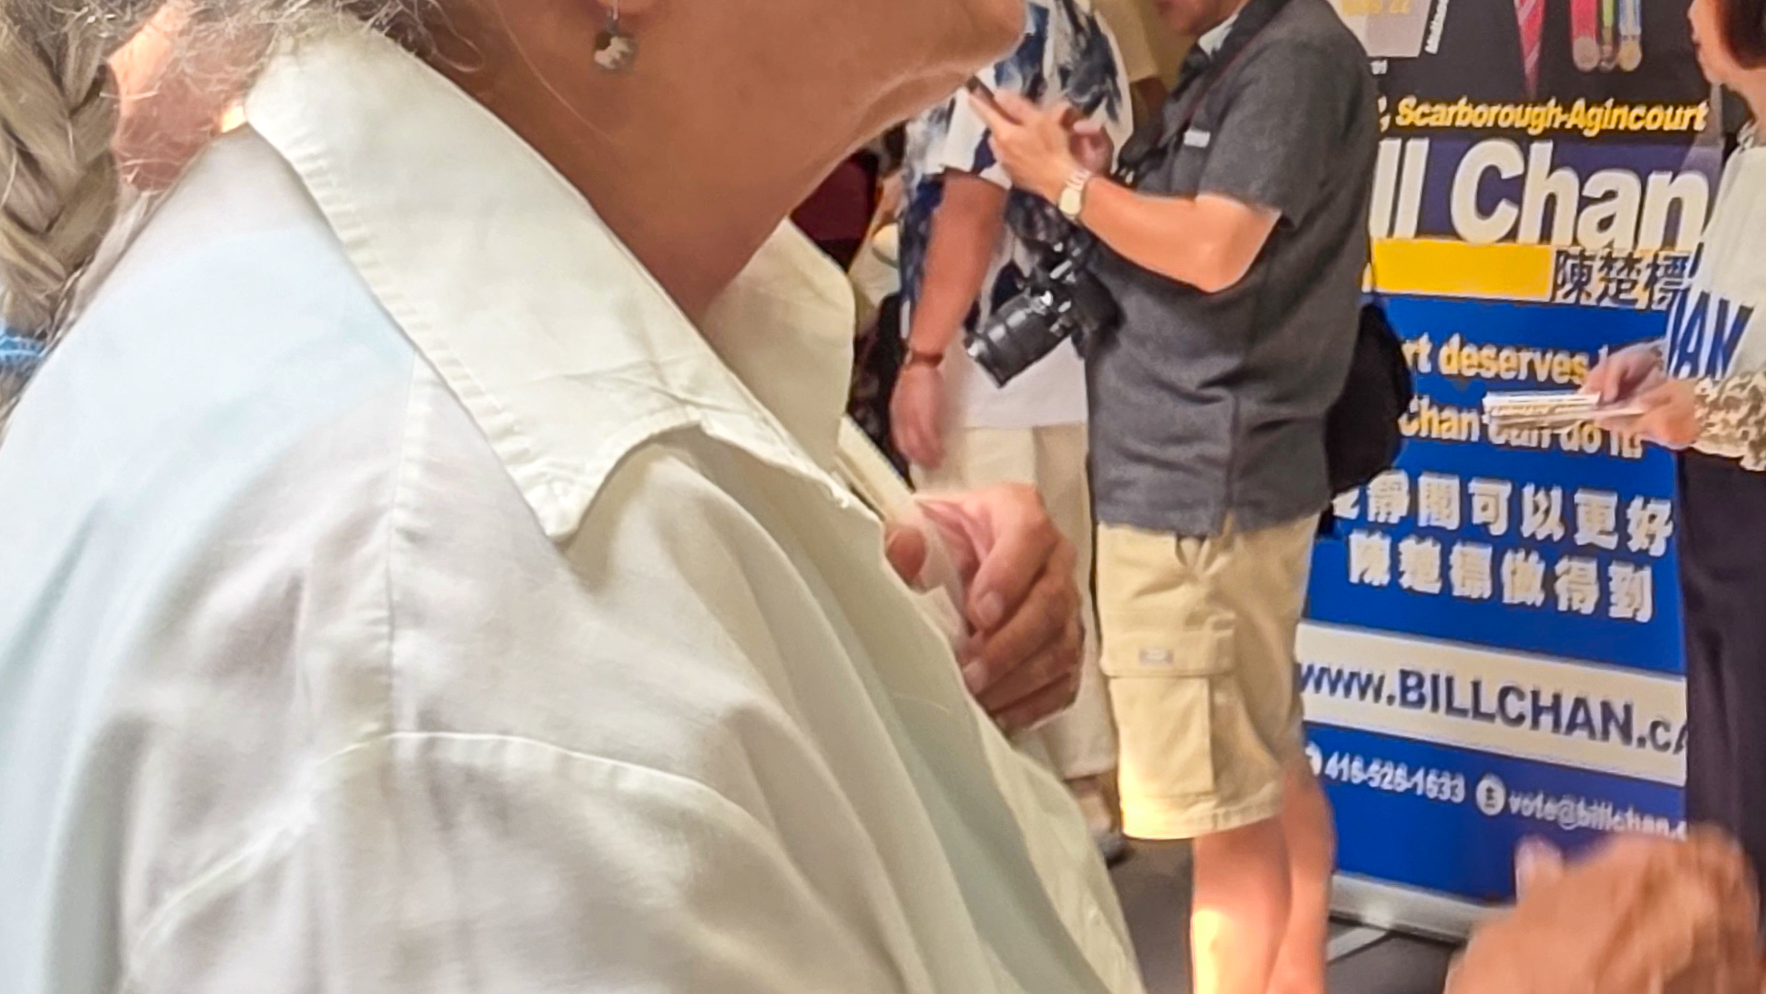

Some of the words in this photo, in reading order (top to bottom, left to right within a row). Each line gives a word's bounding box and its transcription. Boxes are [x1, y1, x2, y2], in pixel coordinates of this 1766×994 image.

[1395, 94, 1708, 138] Scarborough-Agincourt
[1368, 137, 1429, 240] ll
[1450, 137, 1710, 253] Chan
[1438, 333, 1592, 386] deserves
